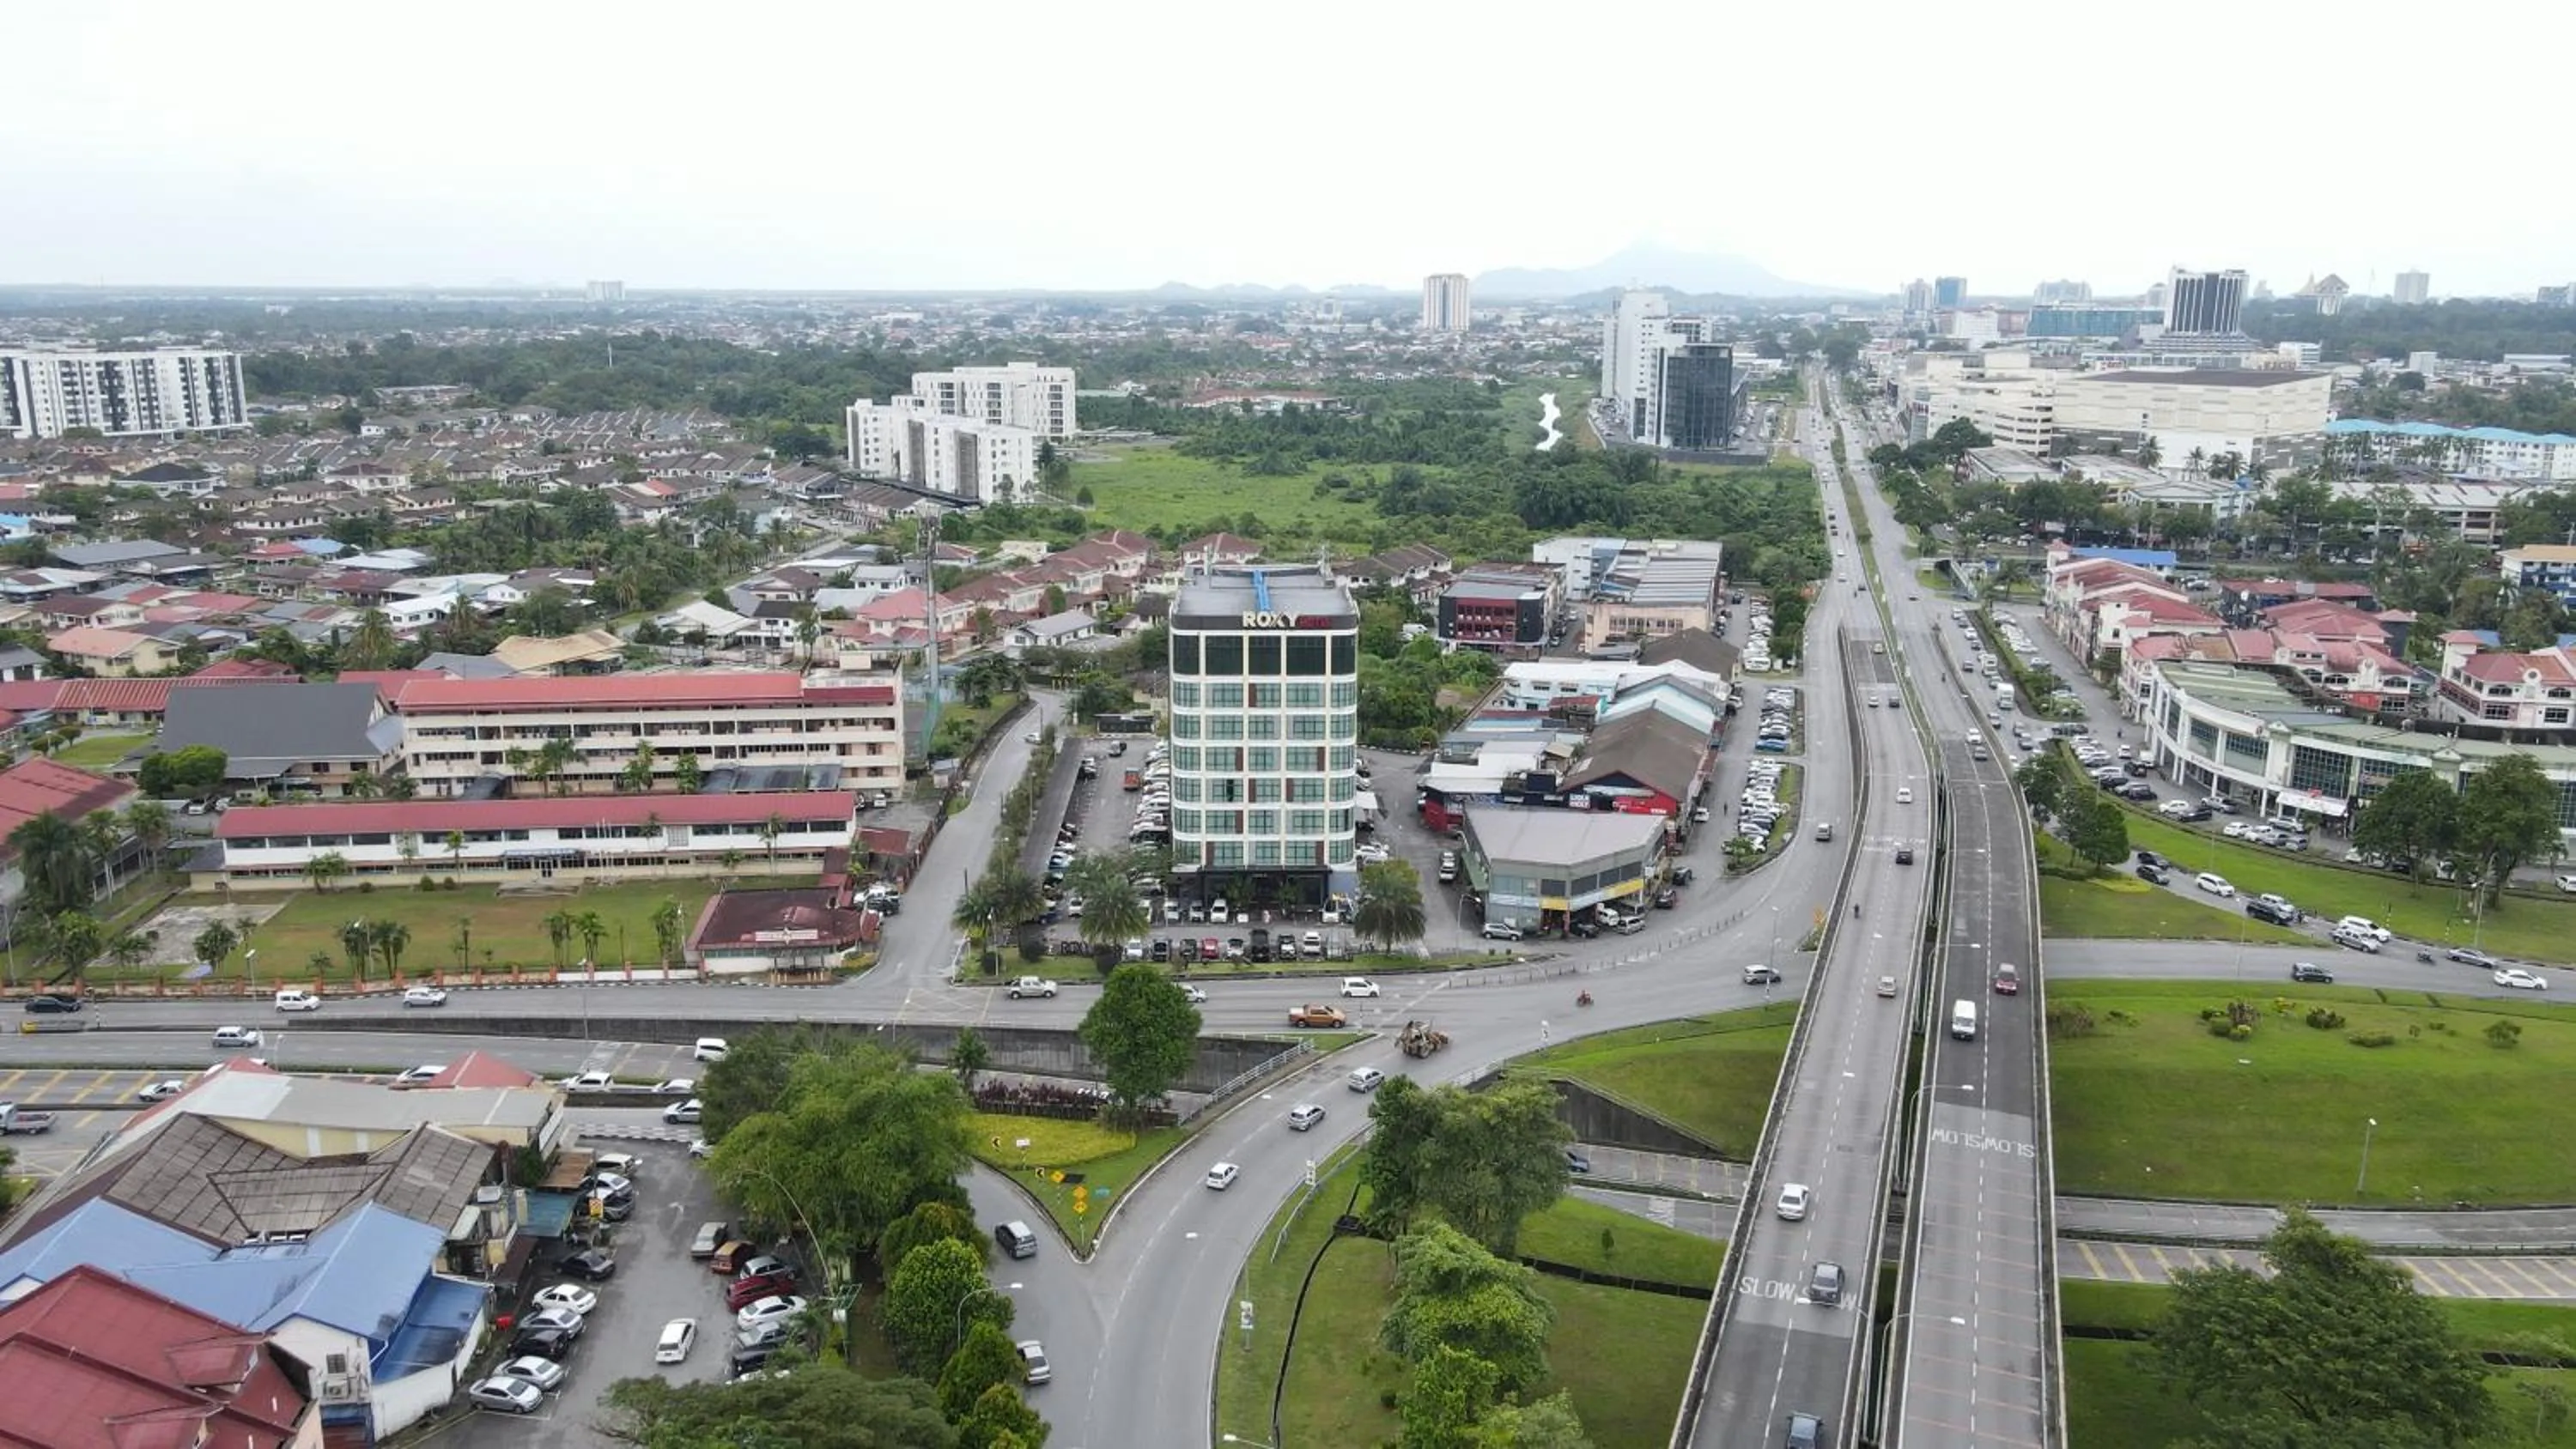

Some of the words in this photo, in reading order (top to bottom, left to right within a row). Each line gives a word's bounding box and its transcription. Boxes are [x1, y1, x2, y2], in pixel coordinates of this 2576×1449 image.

[1242, 610, 1300, 627] ROXY
[1932, 1129, 1982, 1149] SLOW
[1984, 1137, 2034, 1158] SLOW
[1739, 1276, 1796, 1300] SLOW
[1801, 1287, 1857, 1311] SW
